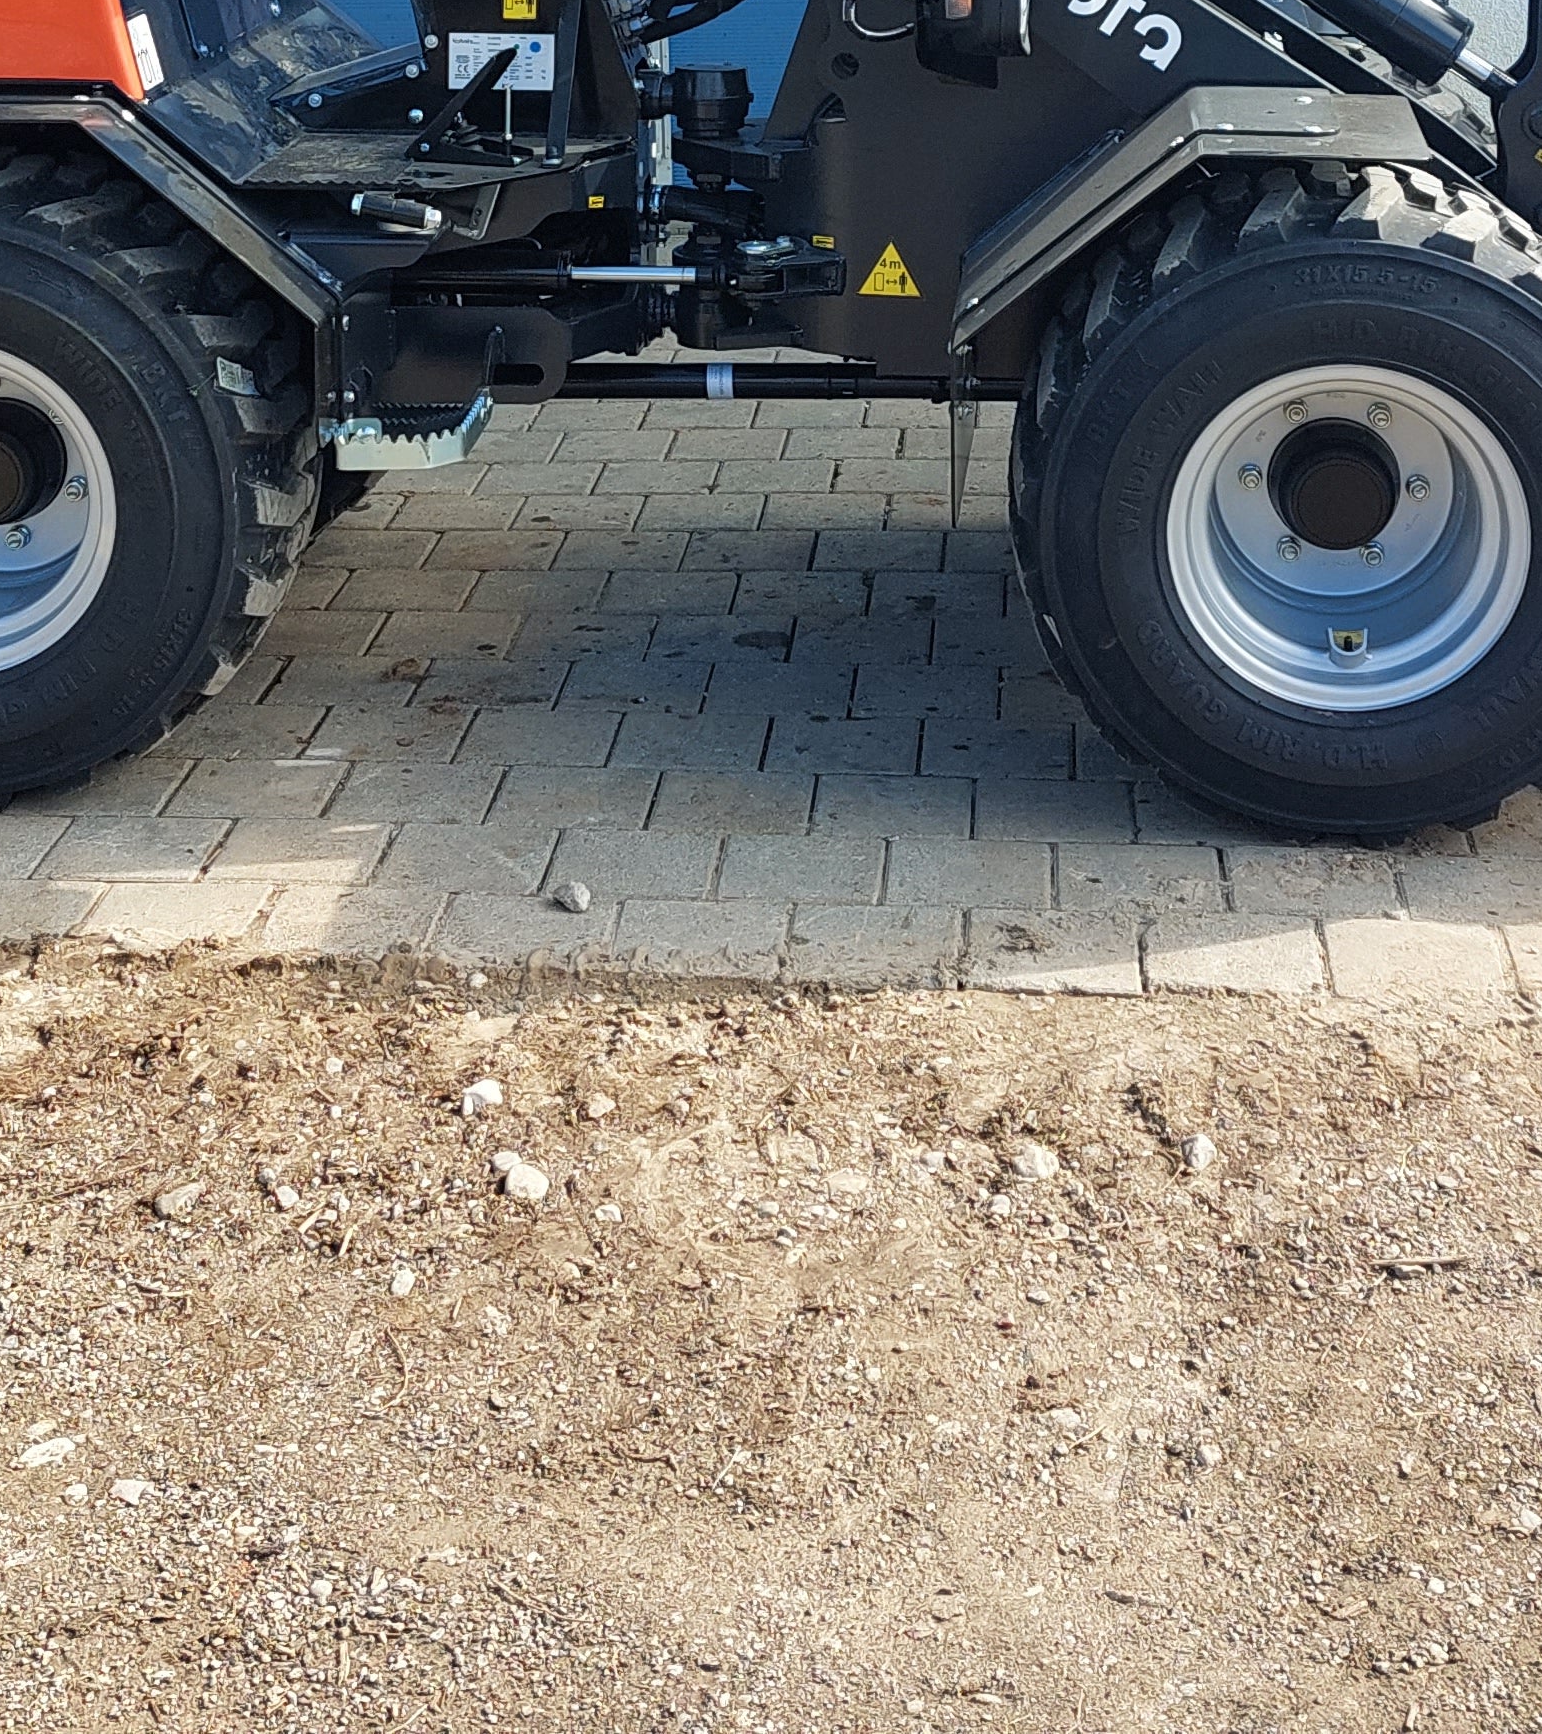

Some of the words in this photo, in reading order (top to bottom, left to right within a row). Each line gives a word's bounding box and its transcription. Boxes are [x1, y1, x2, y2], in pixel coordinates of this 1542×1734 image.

[879, 257, 887, 268] 4
[889, 260, 901, 270] m
[137, 355, 192, 427] BKT
[1083, 376, 1133, 446] BKT
[1114, 441, 1160, 535] WIDE
[1232, 715, 1302, 765] RIM
